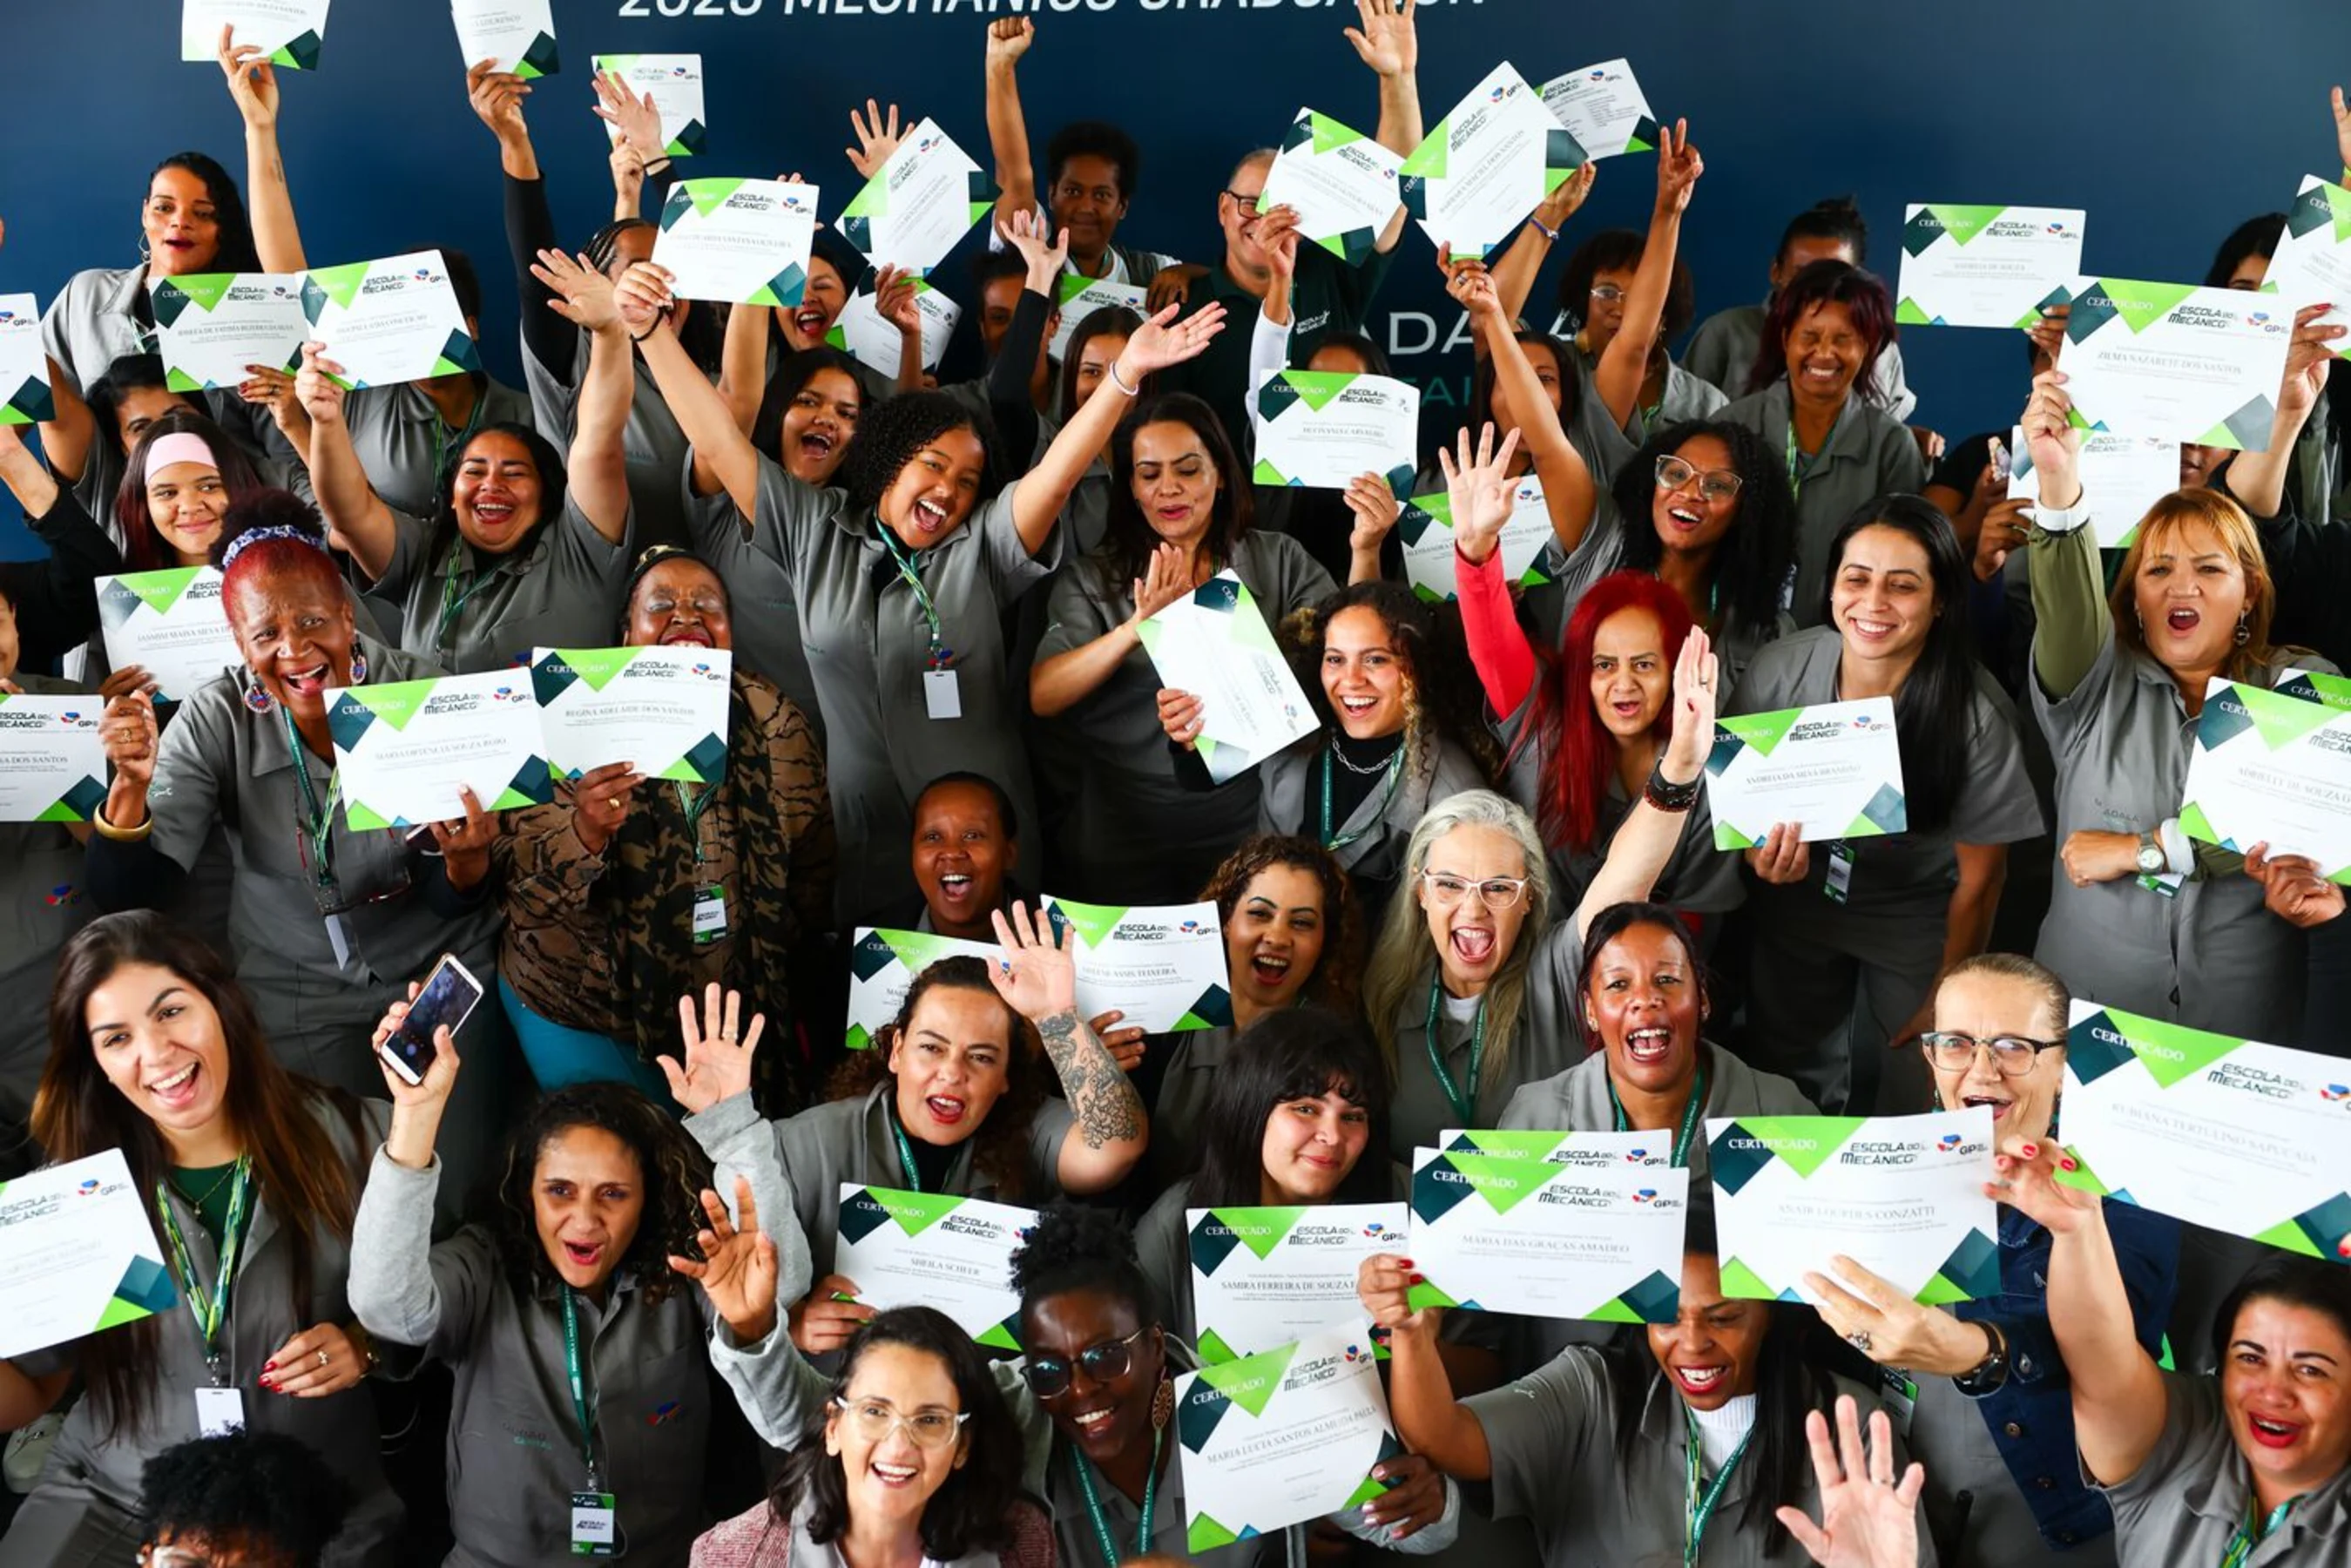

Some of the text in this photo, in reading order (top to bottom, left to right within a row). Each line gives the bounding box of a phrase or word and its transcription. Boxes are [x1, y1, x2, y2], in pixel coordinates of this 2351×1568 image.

[1449, 112, 1479, 141] ESCOLA
[733, 193, 765, 203] ESCOLA
[1993, 221, 2029, 231] ESCOLA
[2086, 296, 2154, 314] CERTIFICADO
[2178, 305, 2221, 318] ESCOLA
[2167, 312, 2227, 329] MECÂNICO
[1346, 389, 1378, 398] ESCOLA
[632, 661, 669, 670] ESCOLA
[624, 669, 674, 679] MECÂNICO
[429, 694, 470, 705] ESCOLA
[424, 701, 477, 715] MECÂNICO
[0, 720, 43, 728] ECÂNICO
[1795, 721, 1833, 733] ESCOLA
[1789, 729, 1840, 741] MECÂNICO
[1119, 924, 1156, 933] ESCOLA
[1113, 930, 1164, 941] MECÂNICO
[2091, 1026, 2186, 1063] CERTIFICADO
[2221, 1063, 2282, 1085] ESCOLA
[2207, 1070, 2293, 1101] MECÂNICO
[1728, 1138, 1818, 1151] CERTIFICADO
[1850, 1142, 1906, 1153] ESCOLA
[1959, 1145, 1977, 1156] GP
[1556, 1150, 1600, 1159] ESCOLA
[1840, 1152, 1916, 1166] MECÂNICO
[1433, 1169, 1518, 1191] CERTIFICADO
[1549, 1184, 1601, 1199] ESCOLA
[1538, 1192, 1611, 1208] MECÂNICO
[856, 1200, 926, 1219] CERTIFICADO
[949, 1214, 991, 1230] ESCOLA
[940, 1220, 996, 1240] MECÂNICO
[1205, 1225, 1273, 1237] CERTIFICADO
[1296, 1226, 1338, 1236] ESCOLA
[1288, 1235, 1345, 1247] MECÂNICO
[1221, 1280, 1349, 1291] SAMIRA FERREIRA DE SOUZA
[1290, 1358, 1328, 1379] ESCOLA
[1283, 1366, 1337, 1393] MECÂNICO
[1192, 1376, 1267, 1406] CERTIFICADO
